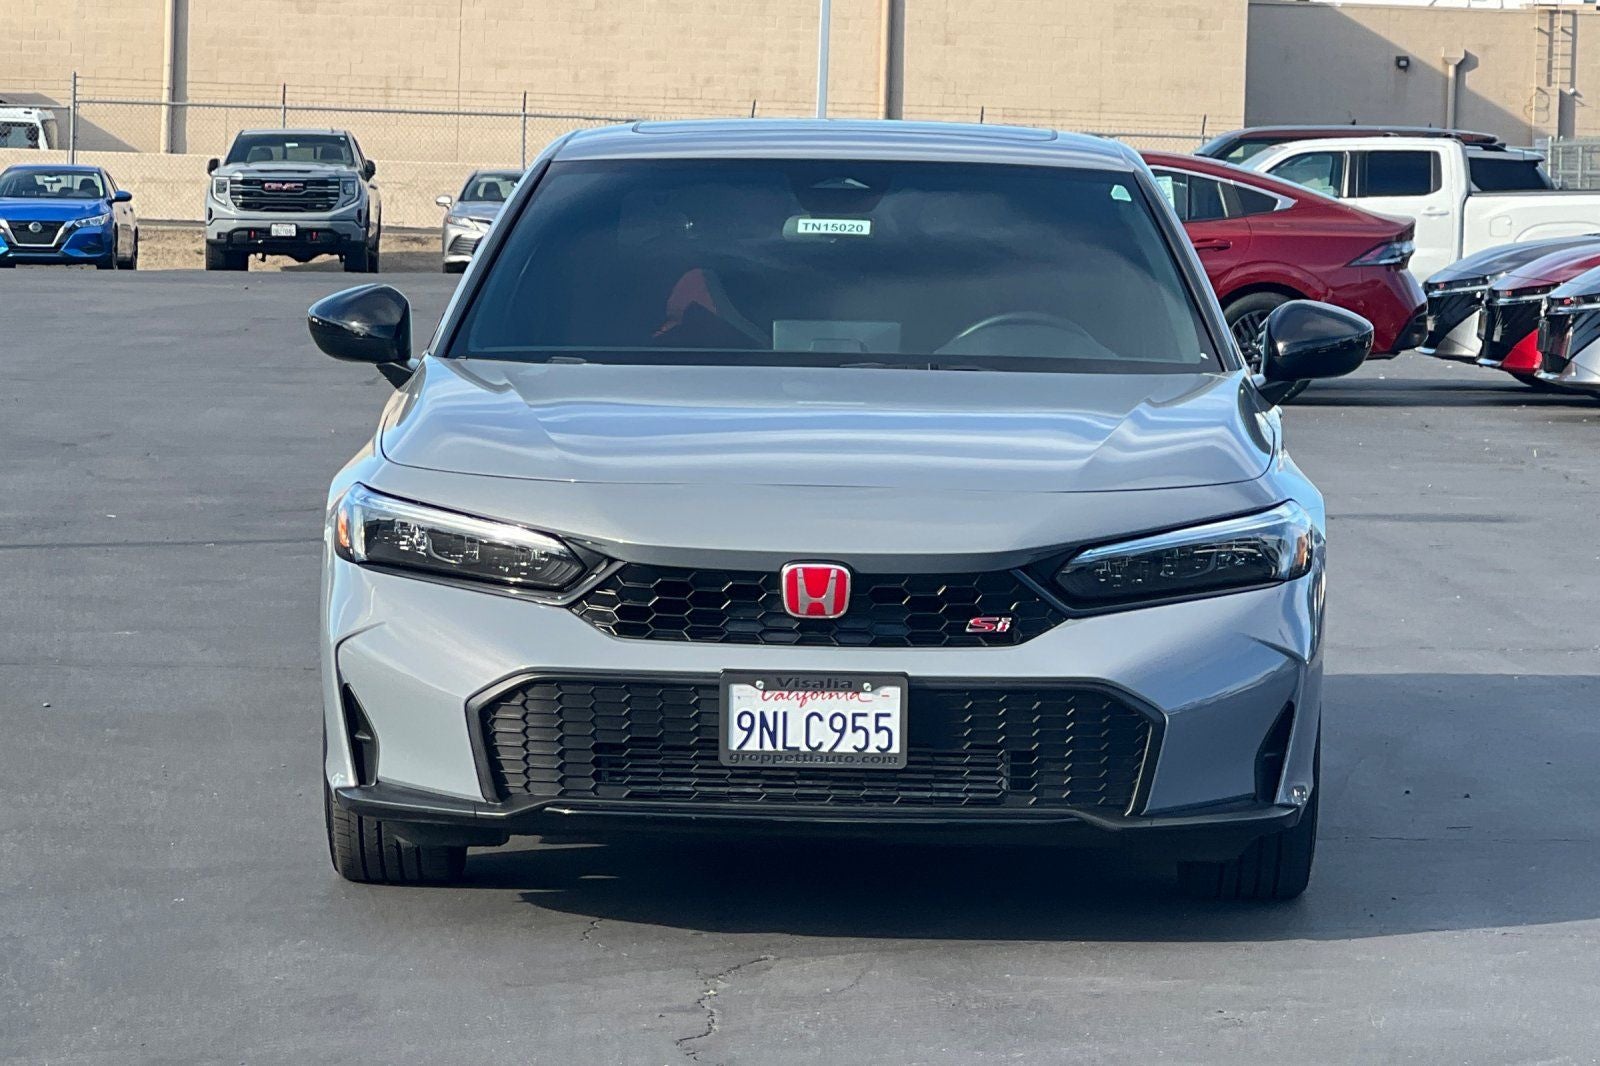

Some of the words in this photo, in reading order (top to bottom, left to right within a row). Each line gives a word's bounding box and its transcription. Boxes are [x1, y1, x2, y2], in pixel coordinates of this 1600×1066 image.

[802, 222, 864, 233] TN15020
[965, 617, 1012, 632] Si
[776, 677, 853, 689] Visalia
[736, 710, 893, 753] 9NLC955
[729, 752, 899, 766] groppettiauto.com
